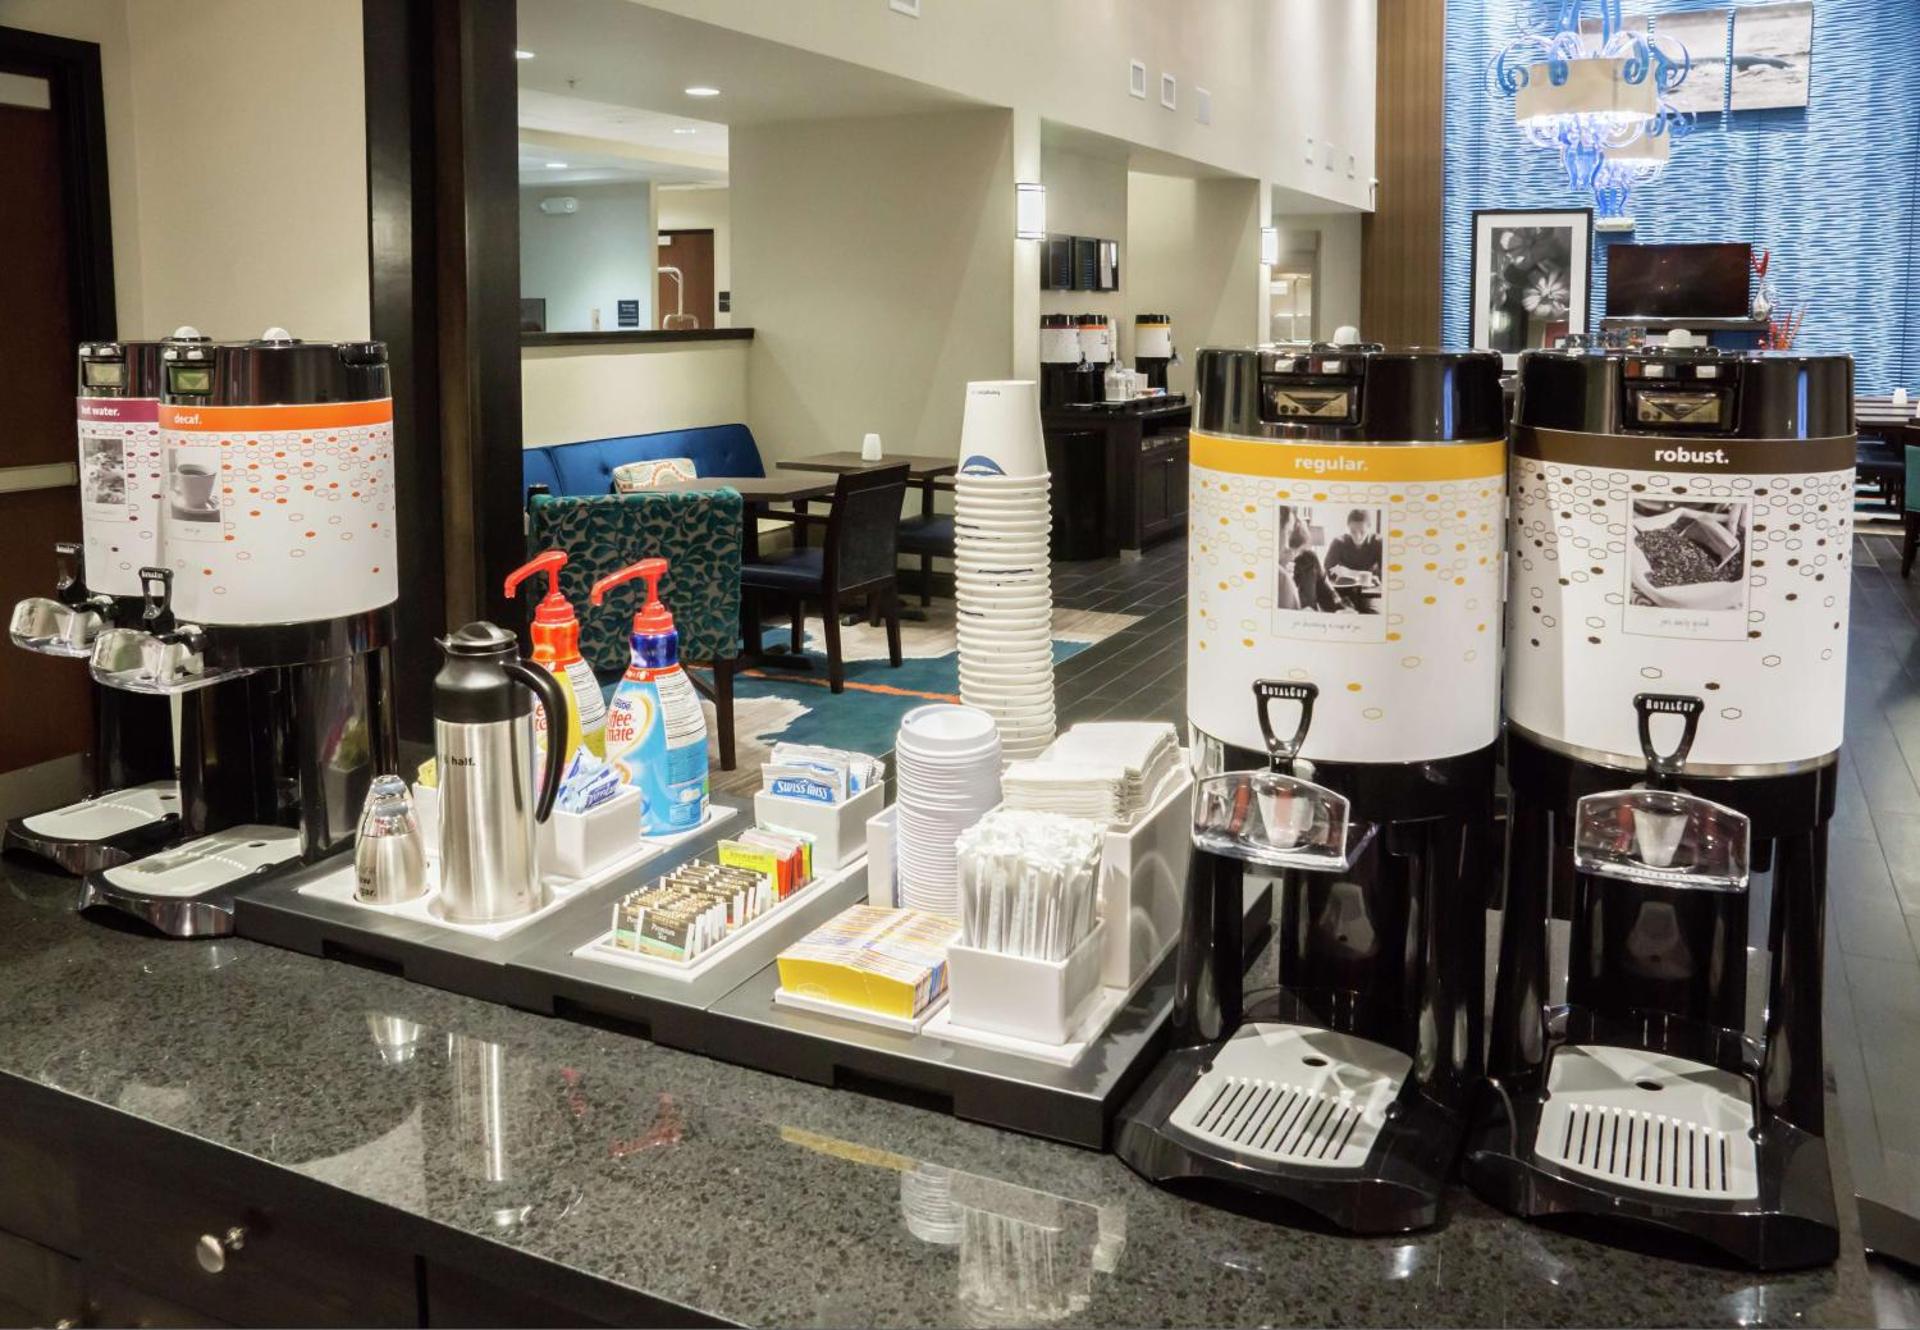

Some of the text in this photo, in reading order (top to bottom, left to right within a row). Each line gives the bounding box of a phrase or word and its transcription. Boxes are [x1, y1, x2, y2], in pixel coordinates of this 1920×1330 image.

[92, 407, 120, 417] water.
[174, 412, 202, 425] decaf.
[1655, 446, 1729, 464] robust.
[1295, 456, 1369, 474] regular.
[451, 755, 476, 767] half.
